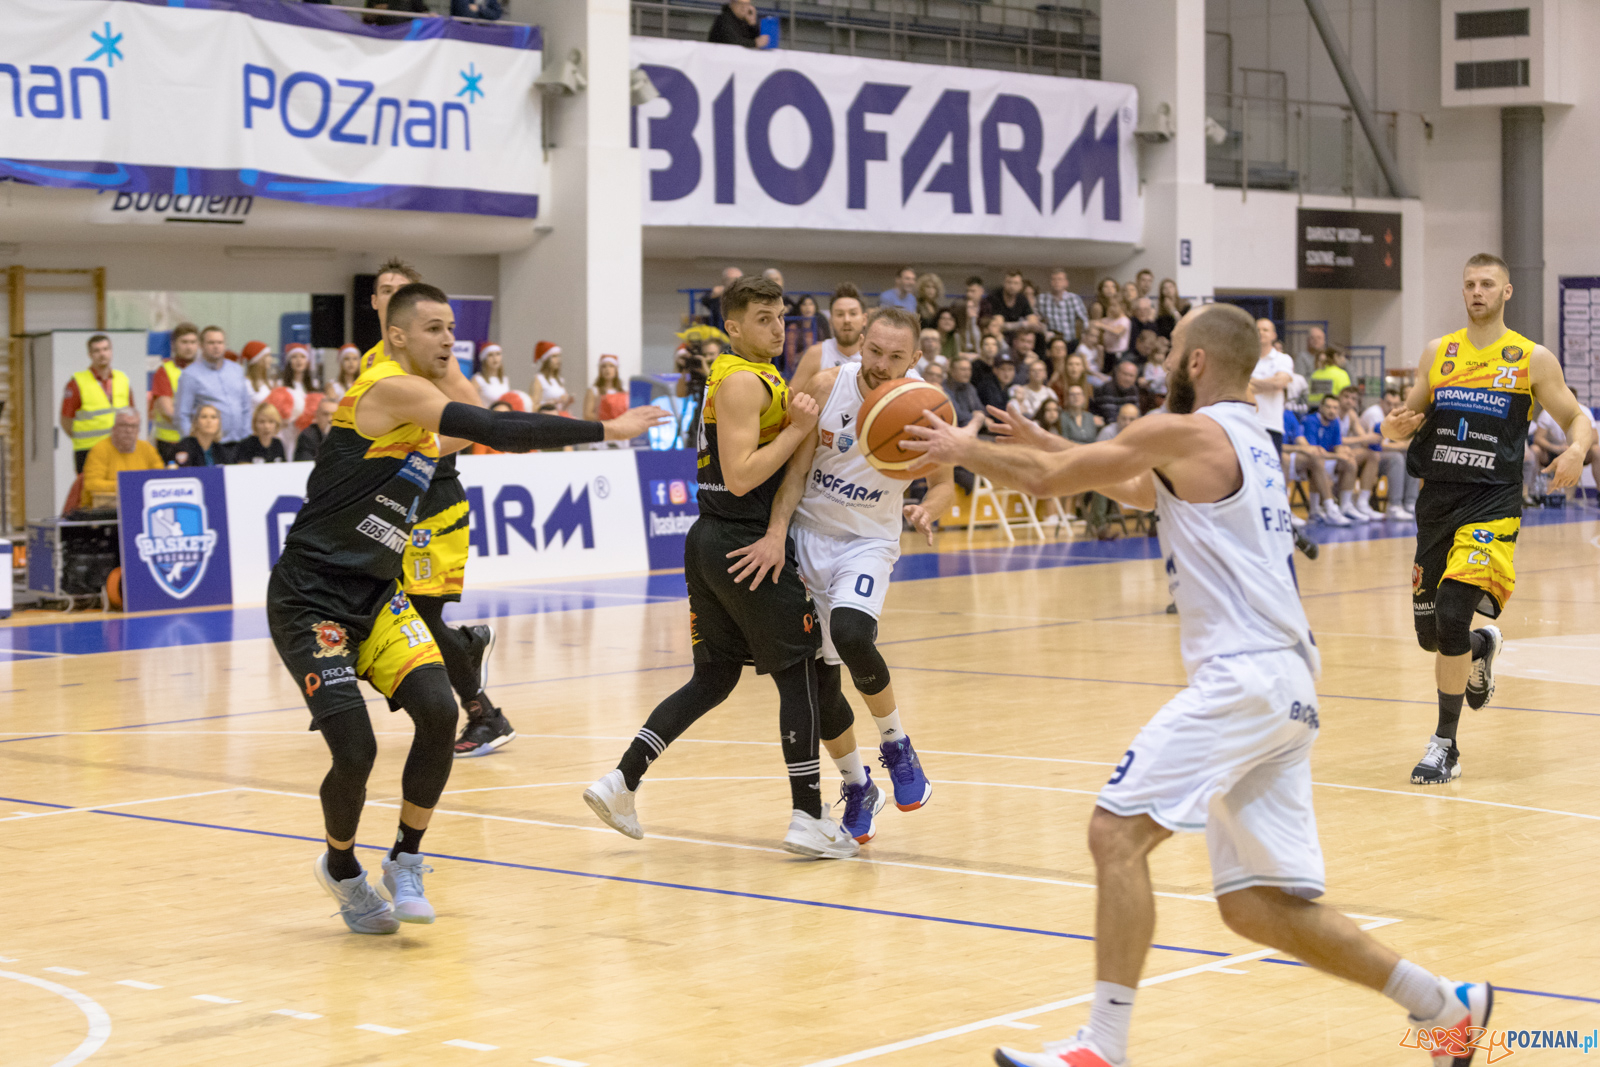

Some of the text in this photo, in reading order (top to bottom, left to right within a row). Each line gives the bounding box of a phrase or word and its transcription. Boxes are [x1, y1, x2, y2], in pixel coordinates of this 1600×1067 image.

[631, 63, 1123, 222] BIOFARM
[1492, 366, 1519, 389] 25
[360, 520, 385, 540] BDS
[140, 535, 210, 555] BASKET
[412, 556, 432, 581] 13
[855, 573, 875, 599] 0
[400, 619, 433, 649] 18
